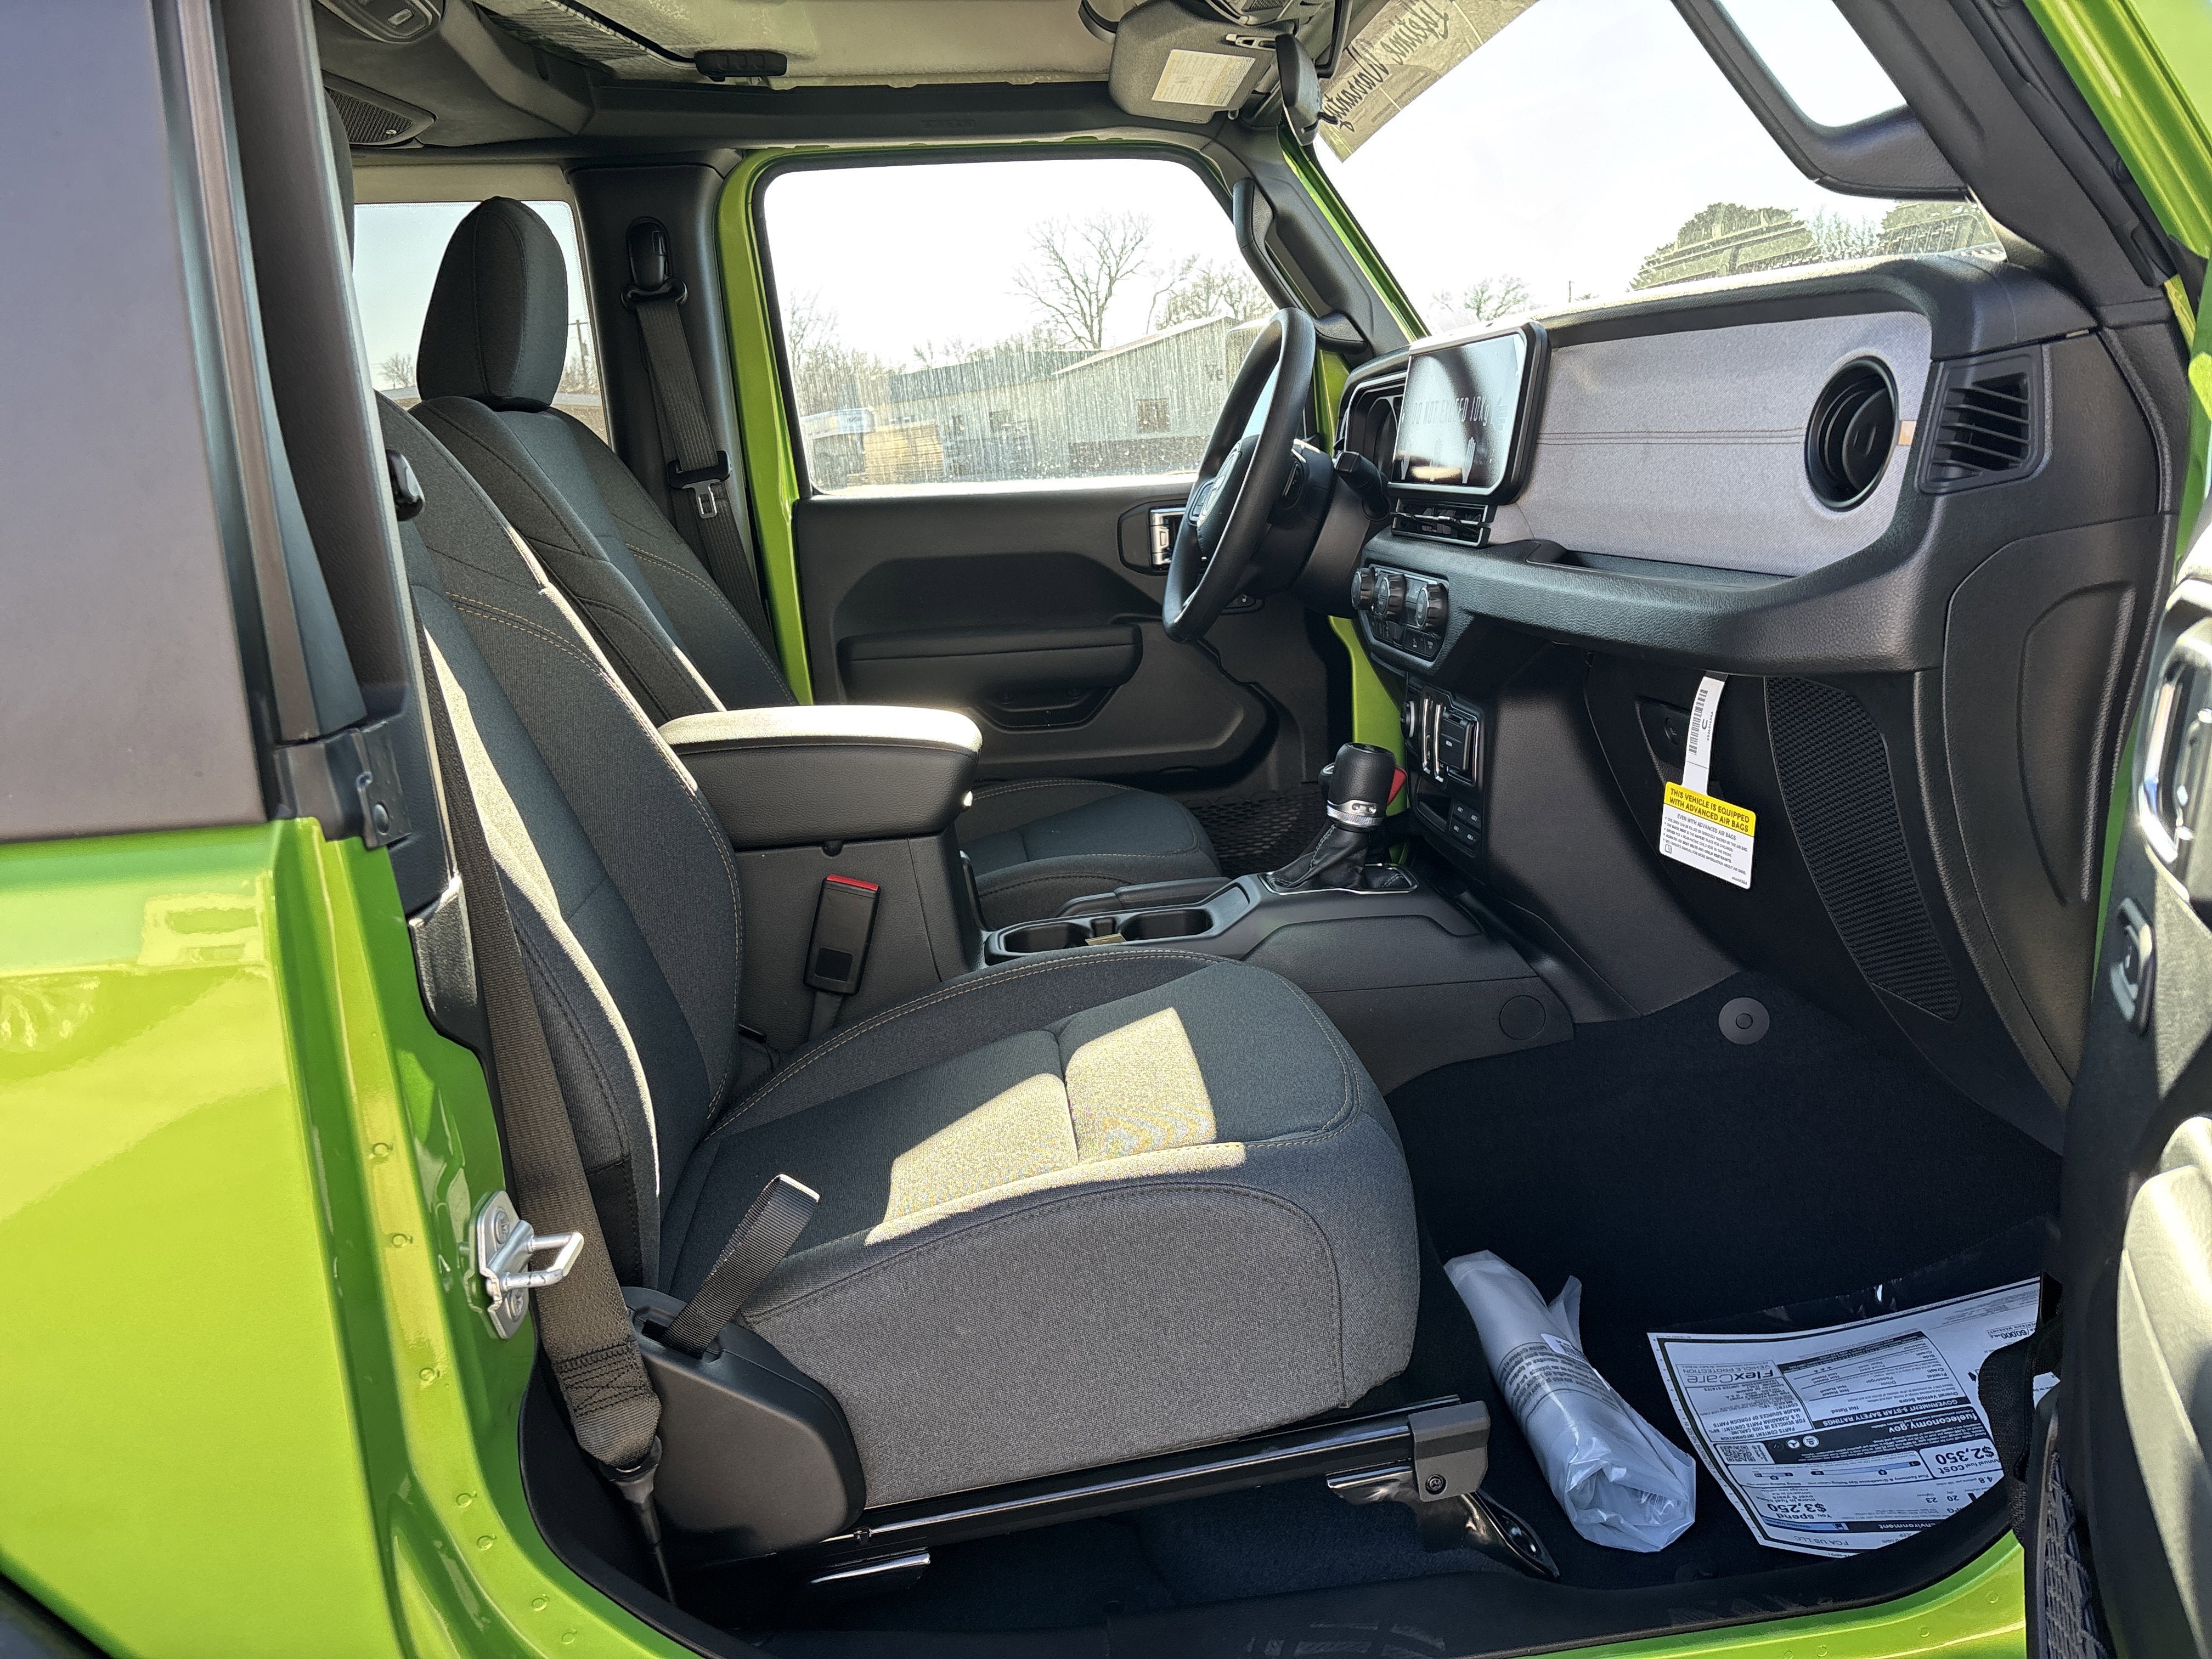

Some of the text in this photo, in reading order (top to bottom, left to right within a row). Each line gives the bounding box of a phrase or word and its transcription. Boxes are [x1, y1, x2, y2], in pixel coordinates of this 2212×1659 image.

[1669, 788, 1750, 823] THIS VEHICLE IS EQUIPPED
[1669, 797, 1748, 832] WITH ADVANCED AIR BAGS
[1677, 813, 1686, 821] EVEN
[1697, 821, 1718, 833] ADVANCED
[1725, 832, 1736, 840] BAGS
[1686, 1369, 1773, 1385] FlexCare
[1759, 1410, 1782, 1419] SOURCES
[1822, 1398, 1958, 1426] GOVERNMENT 5-STAR SAFETY RATINGS
[1729, 1416, 1751, 1424] FOREIGN
[1770, 1420, 1794, 1428] VEHICLES
[1888, 1413, 1977, 1433] fueleconomy.gov
[1934, 1444, 1995, 1466] $2,350
[1937, 1464, 1965, 1475] cost
[1978, 1475, 1993, 1483] 4.8
[1767, 1503, 1827, 1512] $3,250
[1794, 1535, 1811, 1543] LLC
